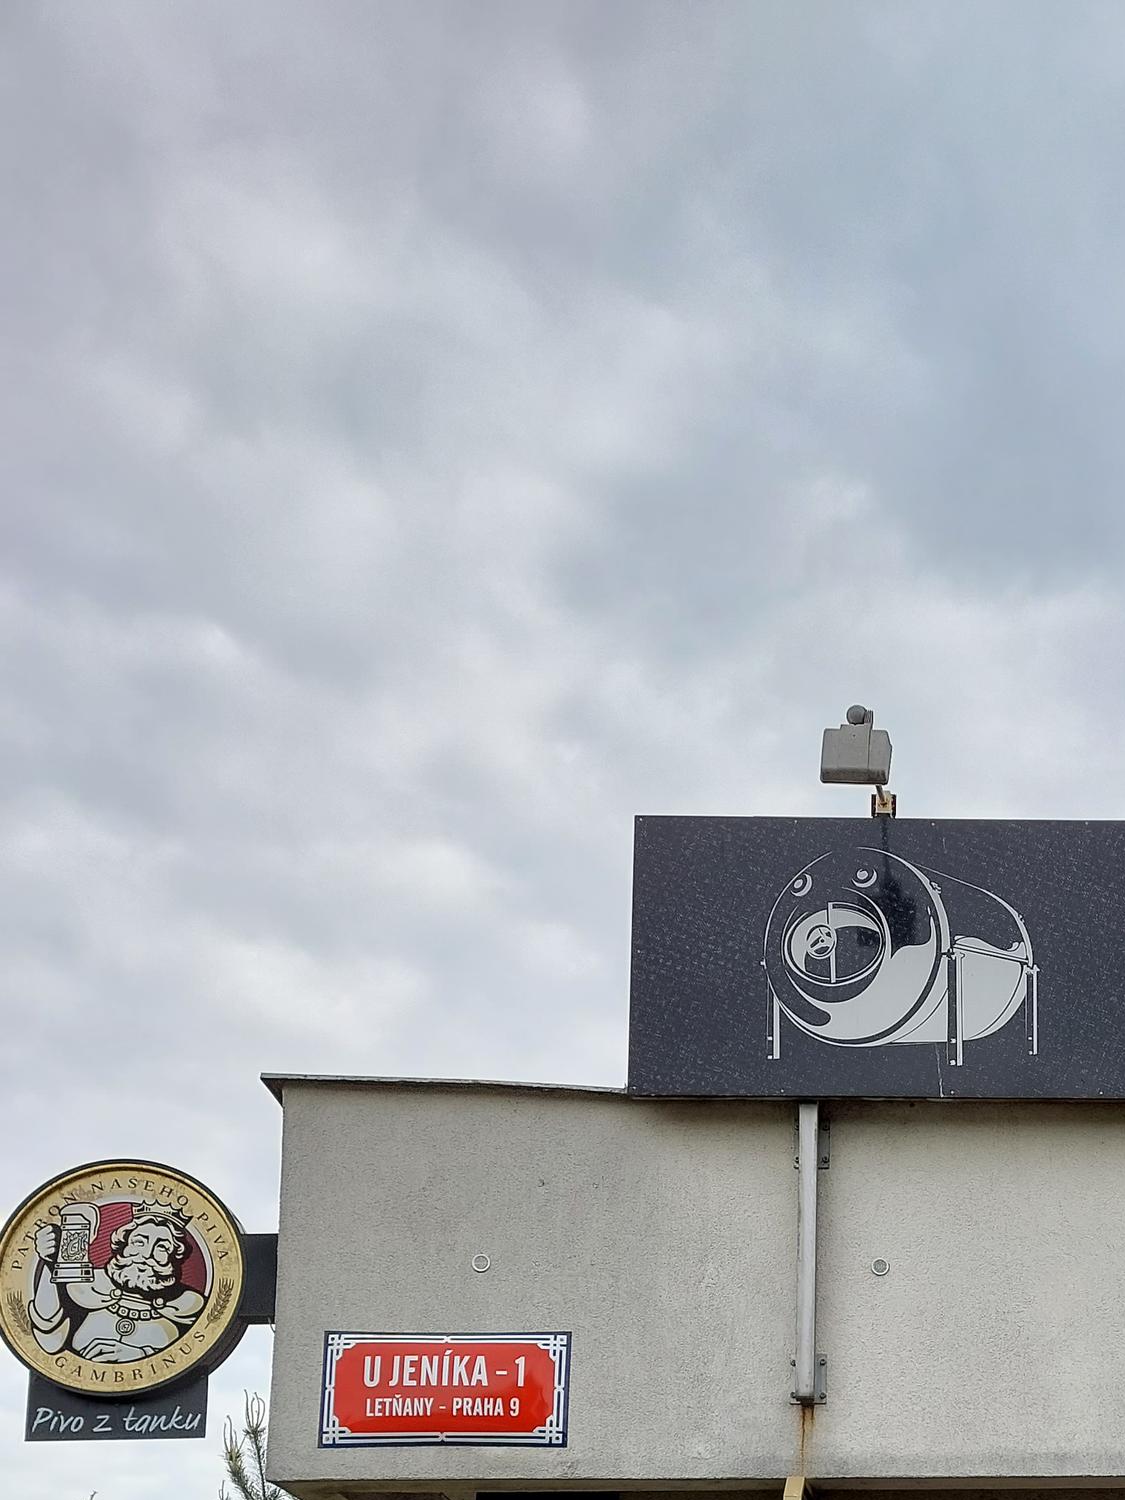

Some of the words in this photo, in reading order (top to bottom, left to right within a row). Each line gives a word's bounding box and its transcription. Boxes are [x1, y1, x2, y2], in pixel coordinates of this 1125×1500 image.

[11, 1192, 78, 1271] PATRON
[196, 1213, 229, 1260] PIVA
[54, 1331, 206, 1383] GAMBRINUS
[363, 1355, 381, 1387] U
[388, 1349, 489, 1387] JENÍKA
[515, 1356, 526, 1387] 1
[31, 1406, 84, 1433] Pivo
[92, 1415, 112, 1433] z
[122, 1406, 202, 1432] tanku
[365, 1394, 434, 1417] LETŇANY
[452, 1397, 504, 1417] PRAHA
[509, 1397, 520, 1417] 9
